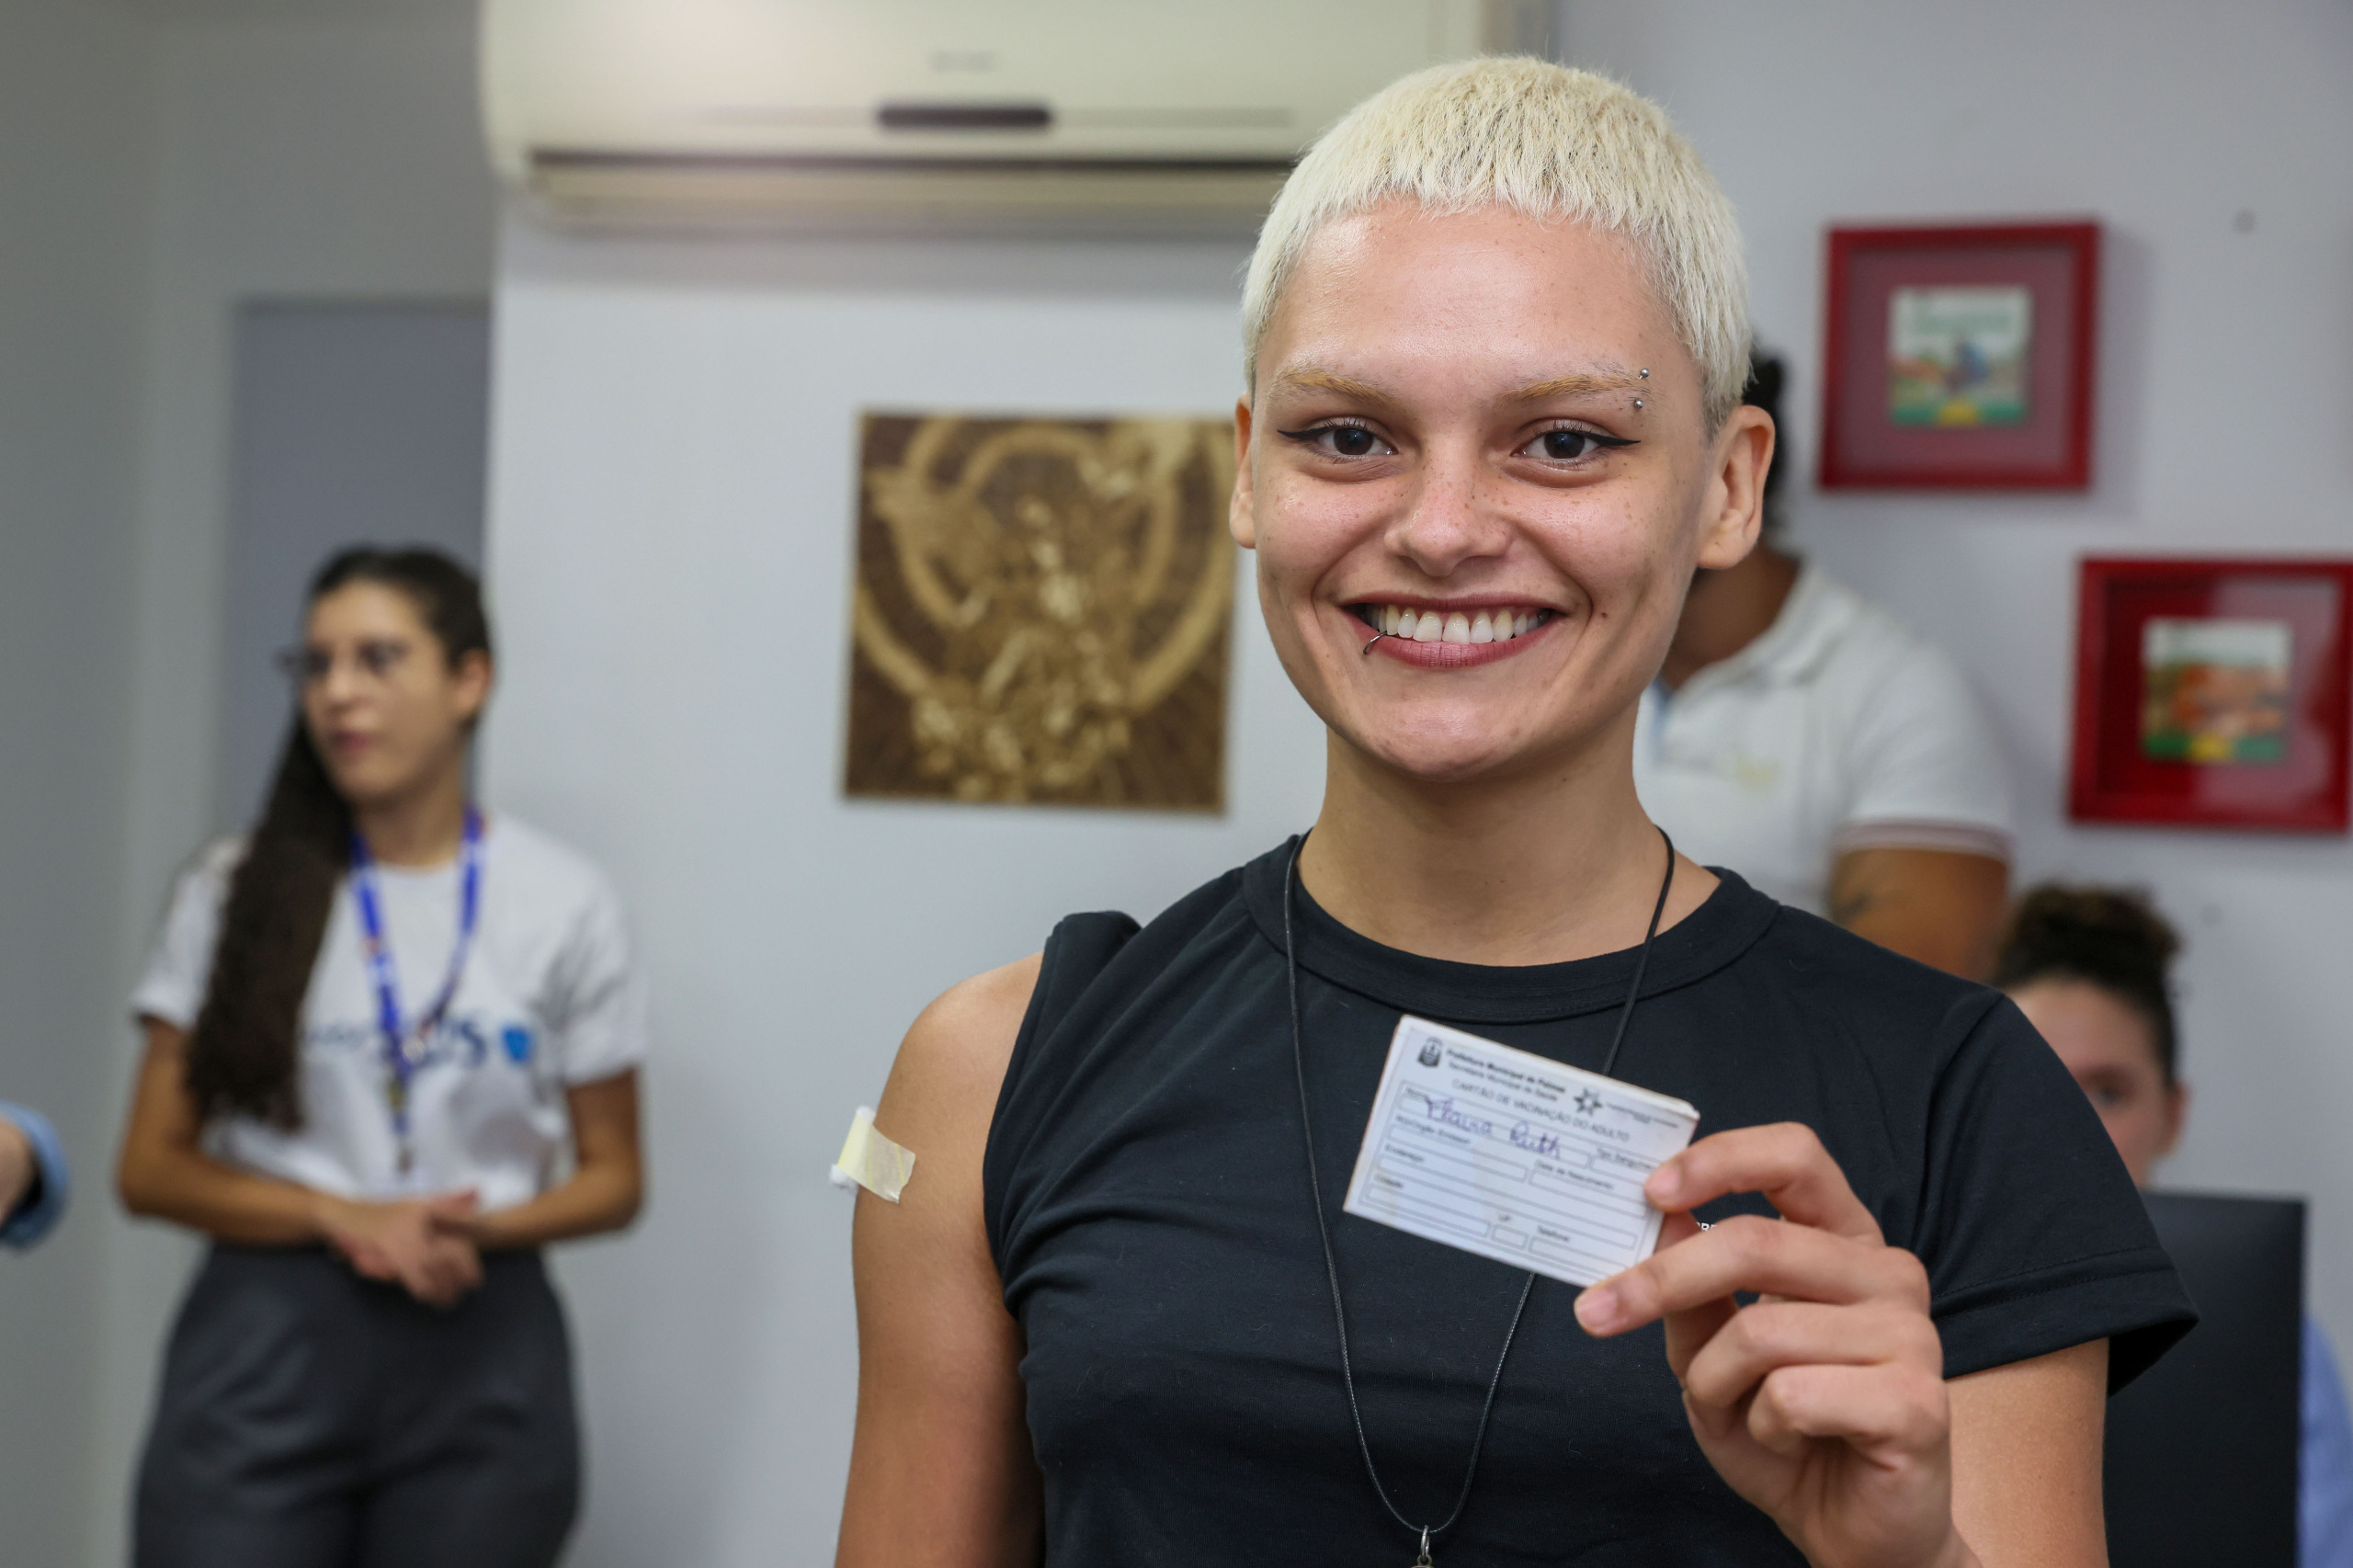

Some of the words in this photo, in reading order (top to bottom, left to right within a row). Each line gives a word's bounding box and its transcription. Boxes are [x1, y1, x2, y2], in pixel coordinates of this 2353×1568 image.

[1487, 1062, 1524, 1080] Municipal
[1486, 1074, 1522, 1090] Municipal
[1451, 1077, 1495, 1099] CARTÃO
[1495, 1092, 1510, 1105] DE
[1513, 1098, 1572, 1125] VACINAÇÃO
[1573, 1118, 1588, 1130] DO
[1592, 1123, 1630, 1142] ADULTO
